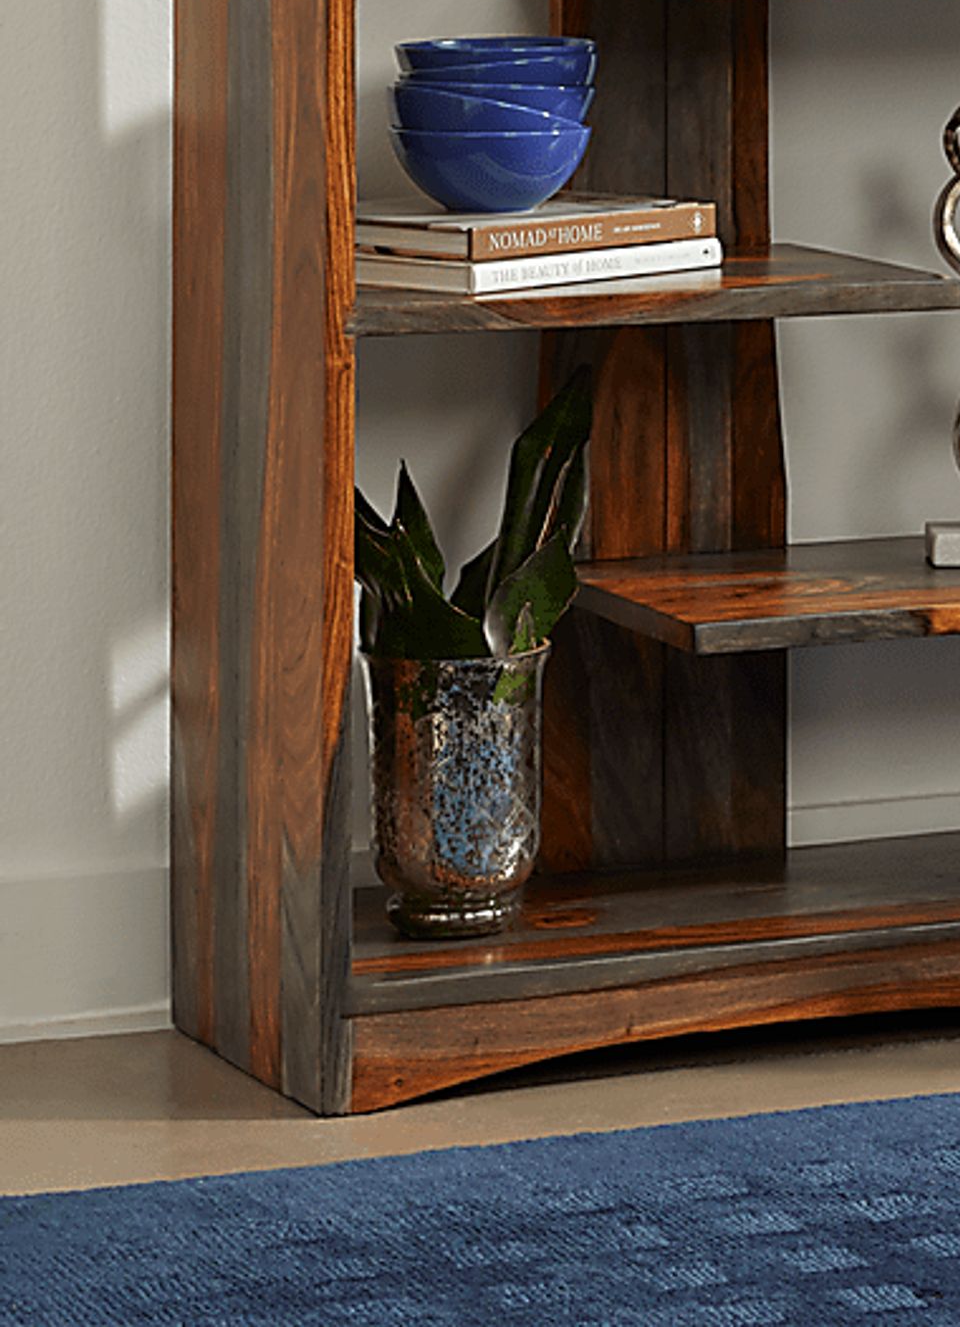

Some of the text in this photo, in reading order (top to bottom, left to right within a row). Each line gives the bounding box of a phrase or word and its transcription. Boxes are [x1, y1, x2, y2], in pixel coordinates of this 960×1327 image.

[489, 228, 547, 251] NOMAD
[557, 223, 602, 244] HOME
[492, 267, 519, 283] THE
[521, 262, 571, 280] BEAUTY
[586, 257, 622, 273] HOME
